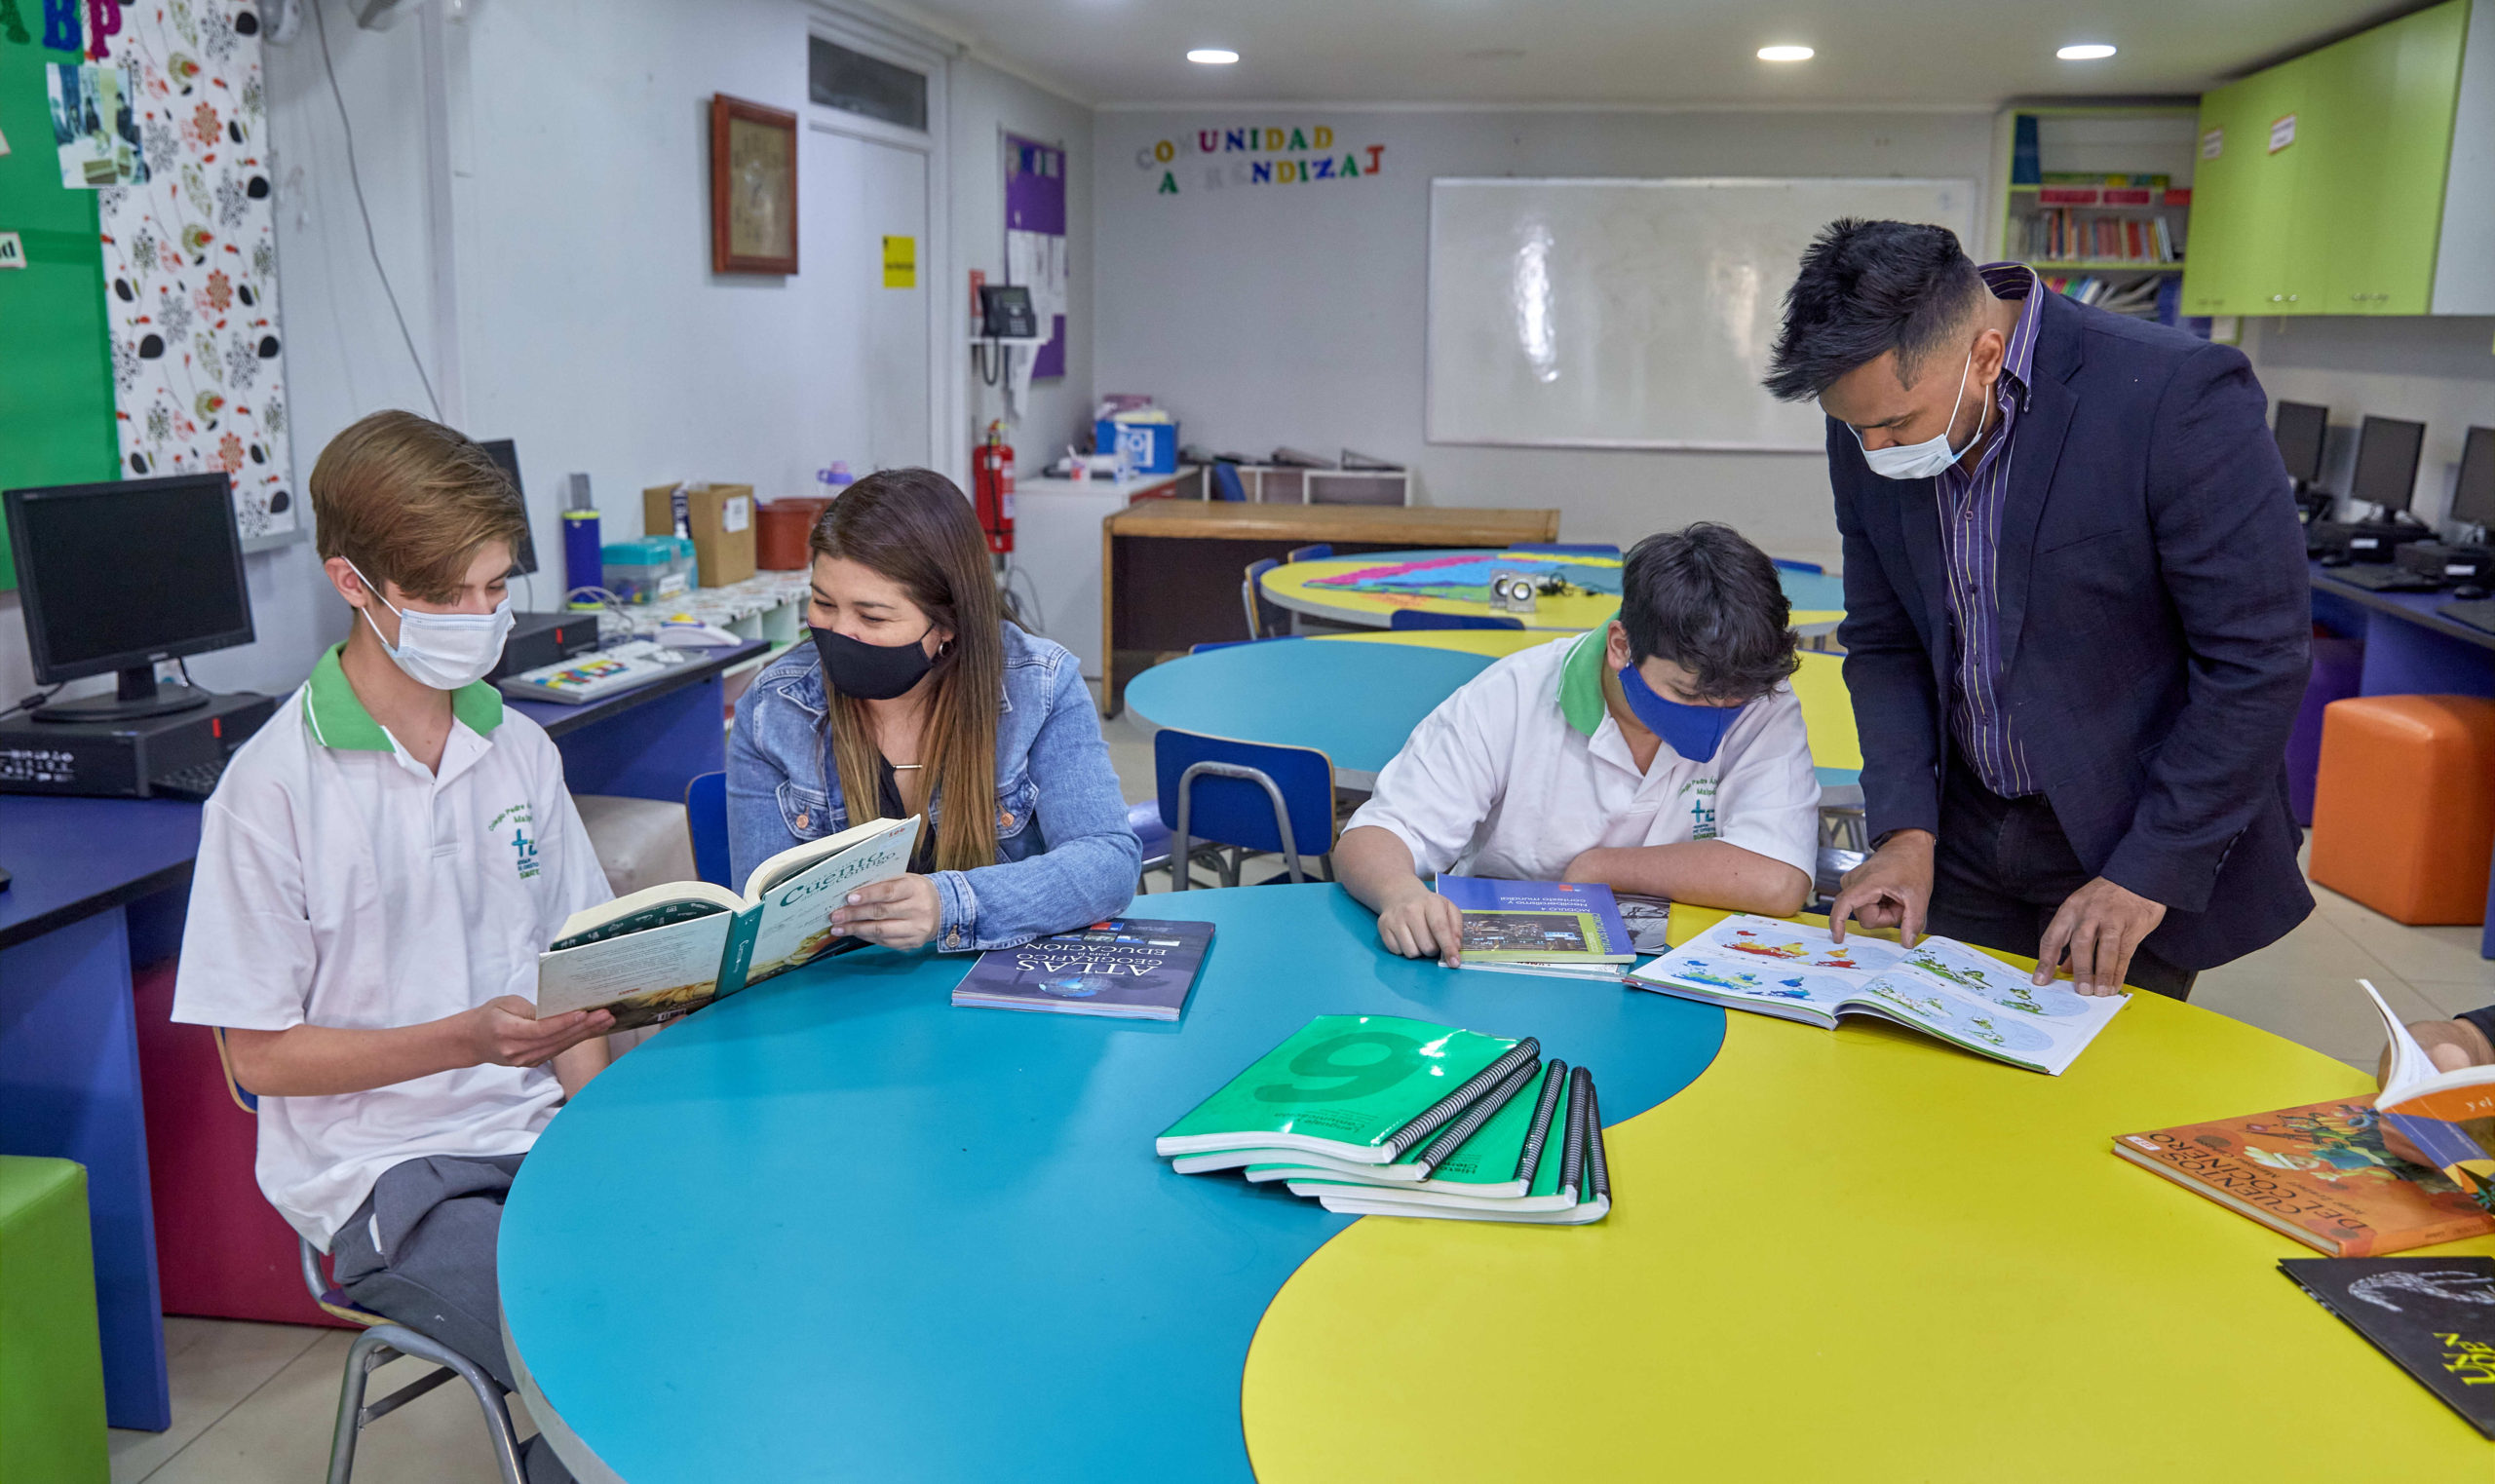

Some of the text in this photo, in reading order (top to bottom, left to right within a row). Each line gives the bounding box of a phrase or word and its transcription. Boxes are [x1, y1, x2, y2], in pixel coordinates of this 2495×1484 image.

[1135, 126, 1334, 171] COMUNIDAD
[780, 851, 884, 907] Cuento
[1016, 953, 1163, 967] GEOGRÁFICO
[1016, 959, 1159, 977] ATLAS
[1023, 942, 1168, 956] EDUCACIÓN
[2147, 1132, 2368, 1231] DEL COCINERO
[2157, 1151, 2301, 1215] CUENTOS
